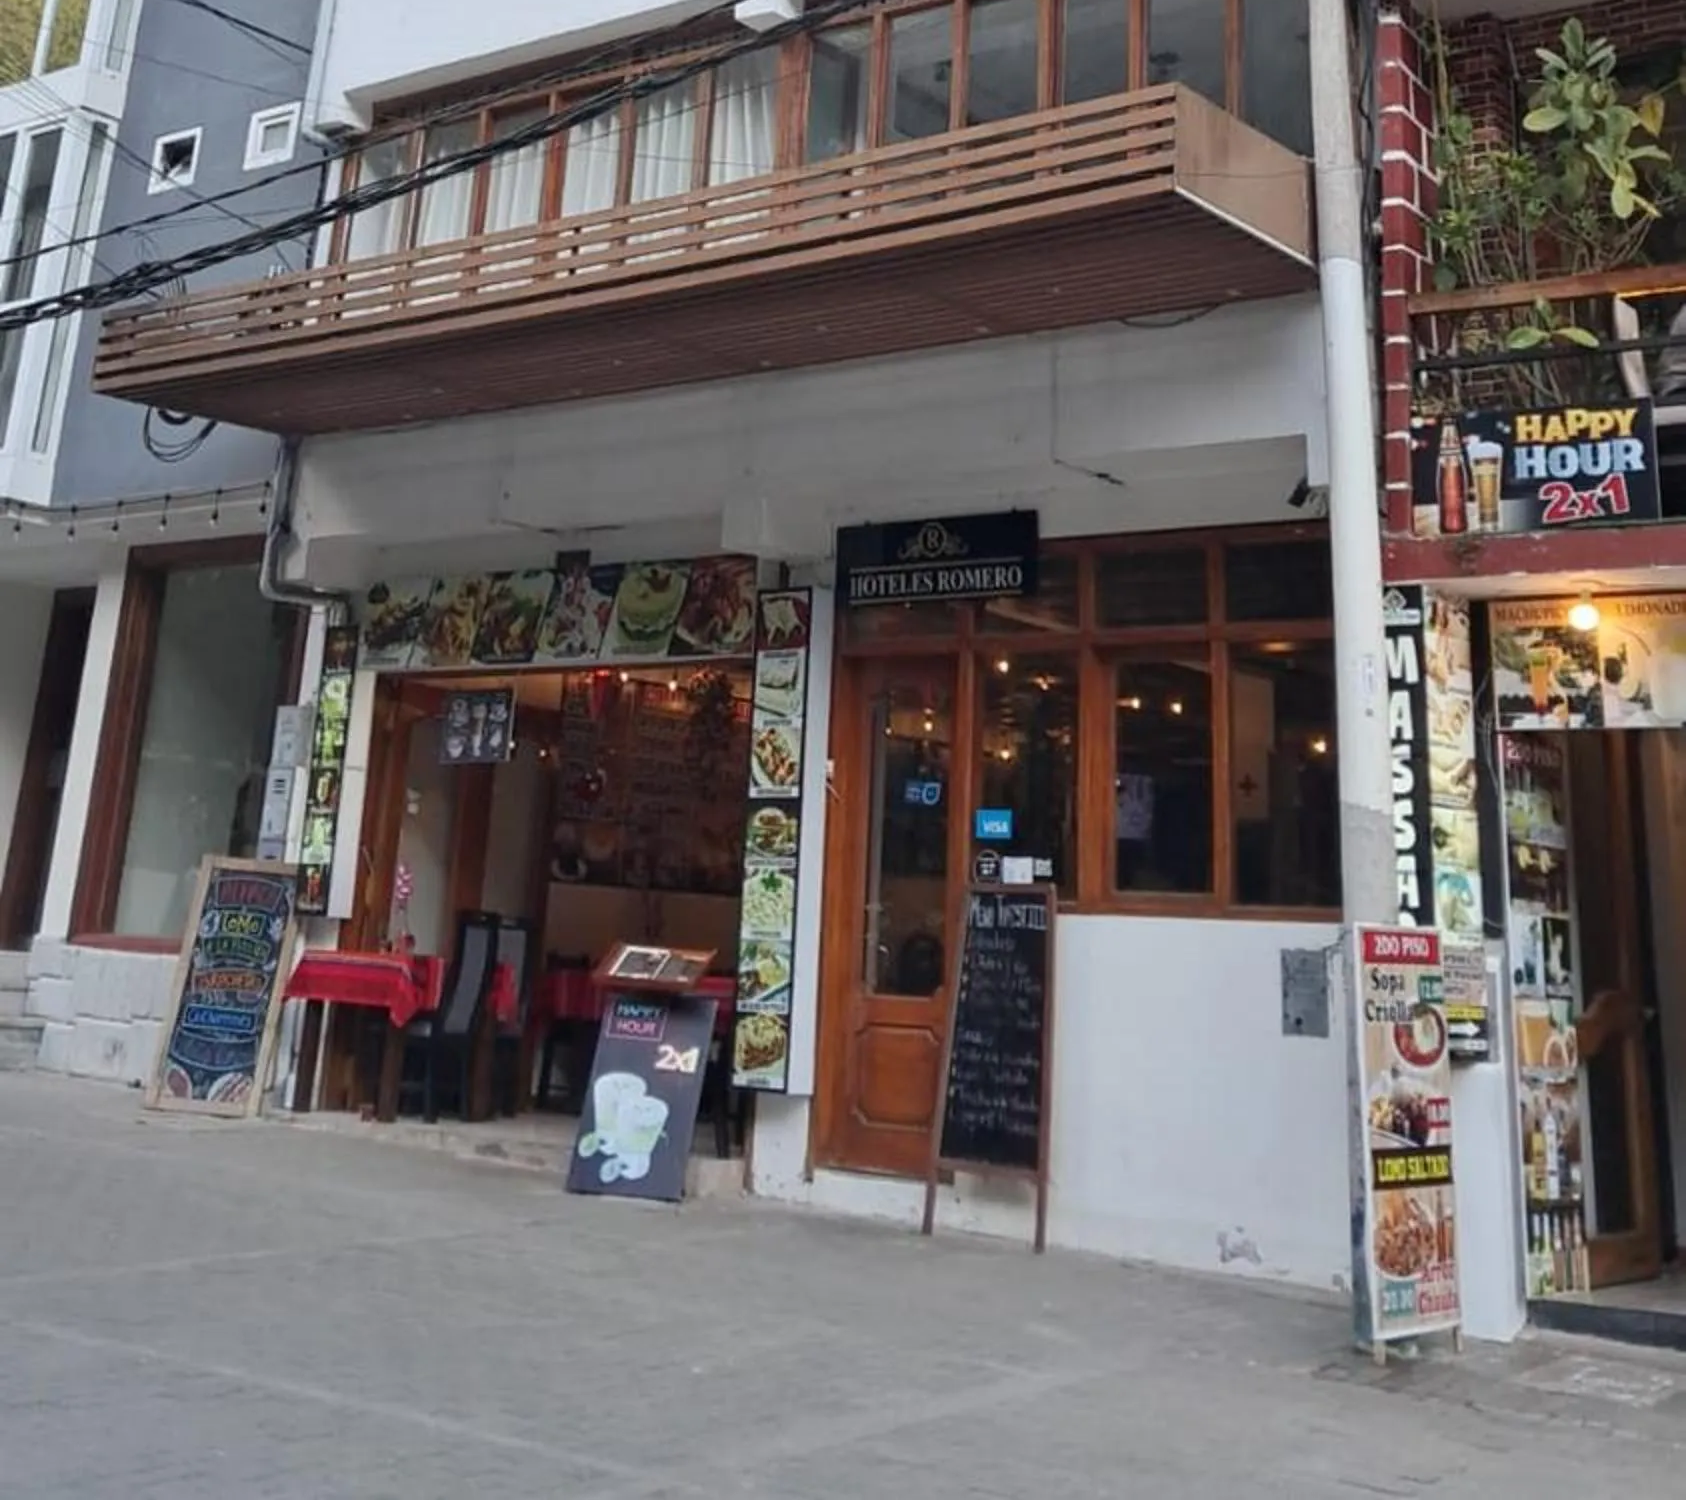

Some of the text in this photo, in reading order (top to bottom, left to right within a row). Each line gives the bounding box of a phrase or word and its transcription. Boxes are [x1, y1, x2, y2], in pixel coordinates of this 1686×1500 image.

[1515, 408, 1638, 443] HAPPY
[1514, 438, 1646, 479] HOUR
[1538, 472, 1631, 524] 2x1
[850, 565, 1023, 598] HOTELES ROMERO
[983, 819, 1009, 833] VISA
[1401, 936, 1430, 957] PISO
[1371, 967, 1405, 997] Sopa
[616, 1019, 656, 1035] HOUR
